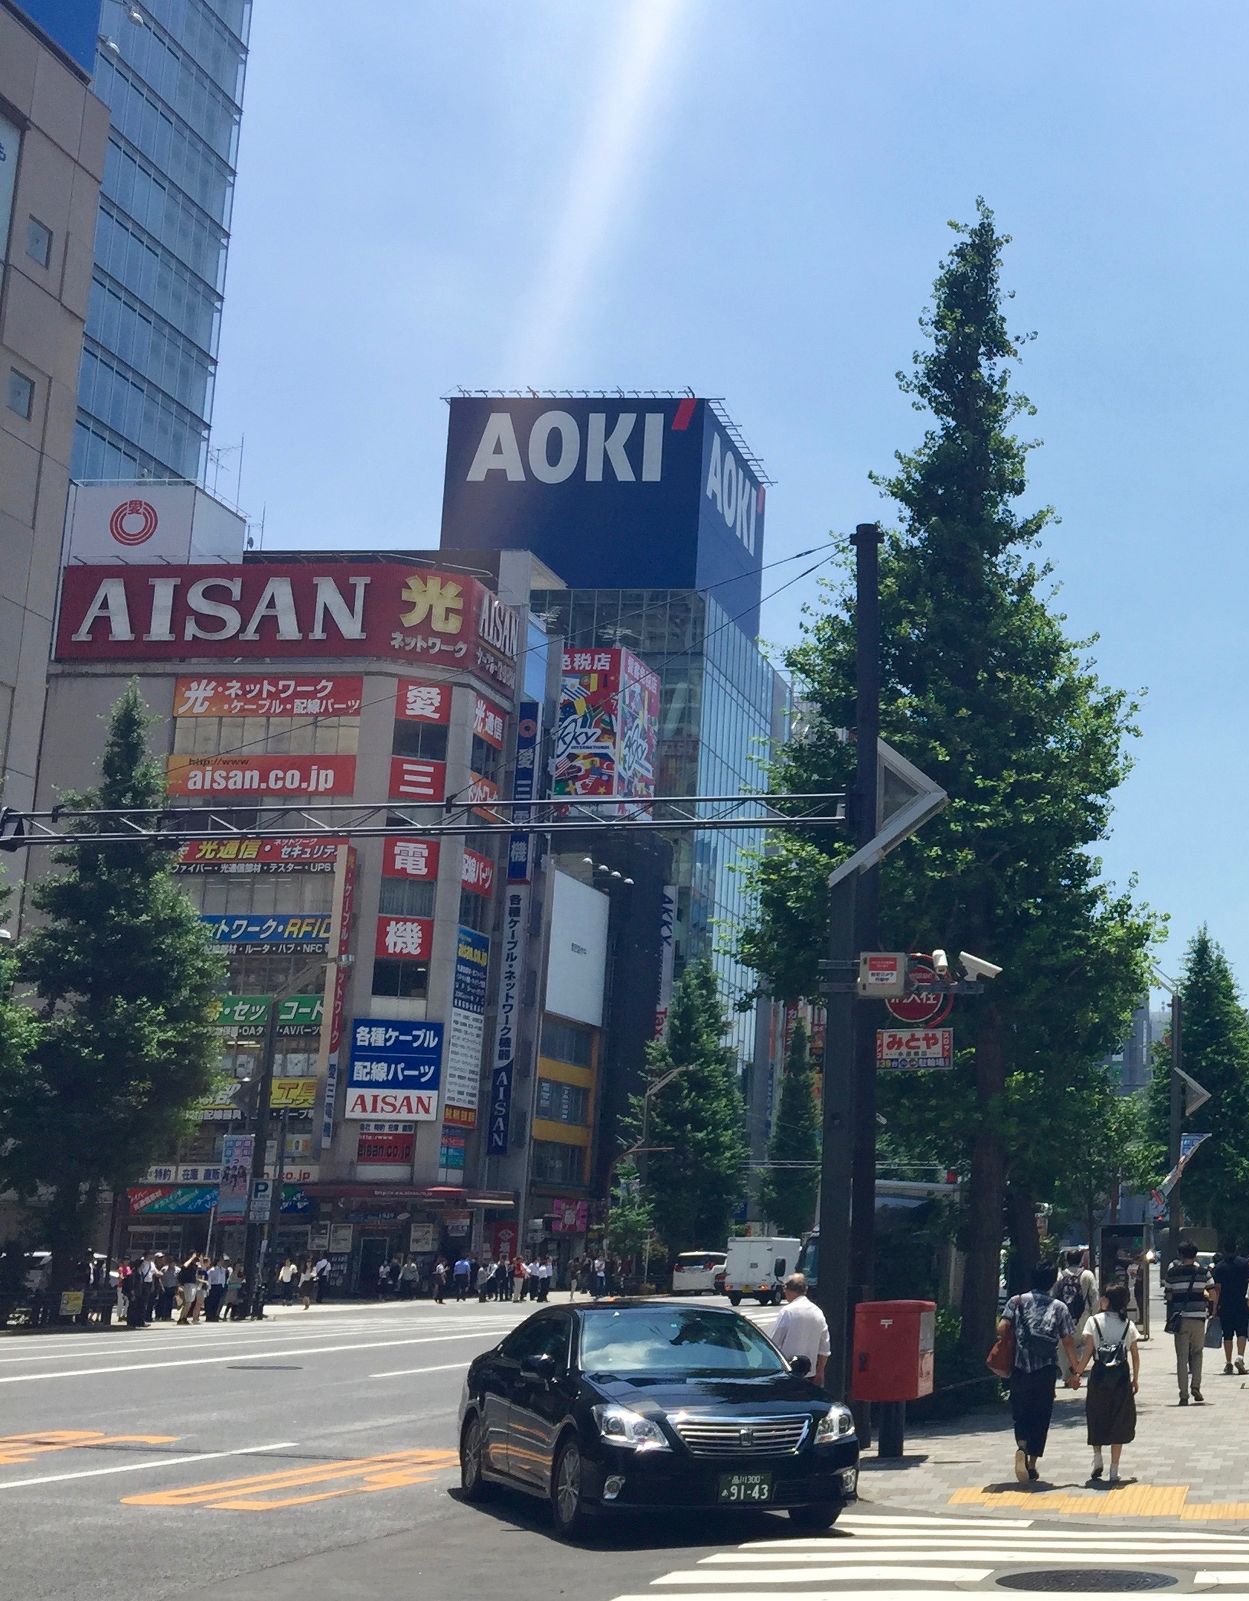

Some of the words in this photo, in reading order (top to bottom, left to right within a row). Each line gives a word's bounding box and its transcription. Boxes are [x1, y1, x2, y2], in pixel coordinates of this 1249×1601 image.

[466, 411, 664, 484] AOKI
[705, 431, 758, 557] AOKI
[71, 576, 371, 643] AISAN
[400, 574, 464, 635] 光
[478, 591, 520, 663] AISAN
[391, 631, 467, 659] ネットワーク
[405, 685, 442, 719] 愛
[187, 765, 335, 792] aisan.co.jp
[394, 841, 428, 875] 電
[385, 920, 422, 955] 機
[356, 1026, 438, 1049] 各種ケーブル
[886, 1032, 939, 1050] みとや
[353, 1061, 434, 1083] 配線パーツ
[350, 1094, 433, 1115] AISAN
[491, 1071, 509, 1148] AISAN
[254, 1182, 269, 1200] P
[730, 1484, 769, 1500] 91-43
